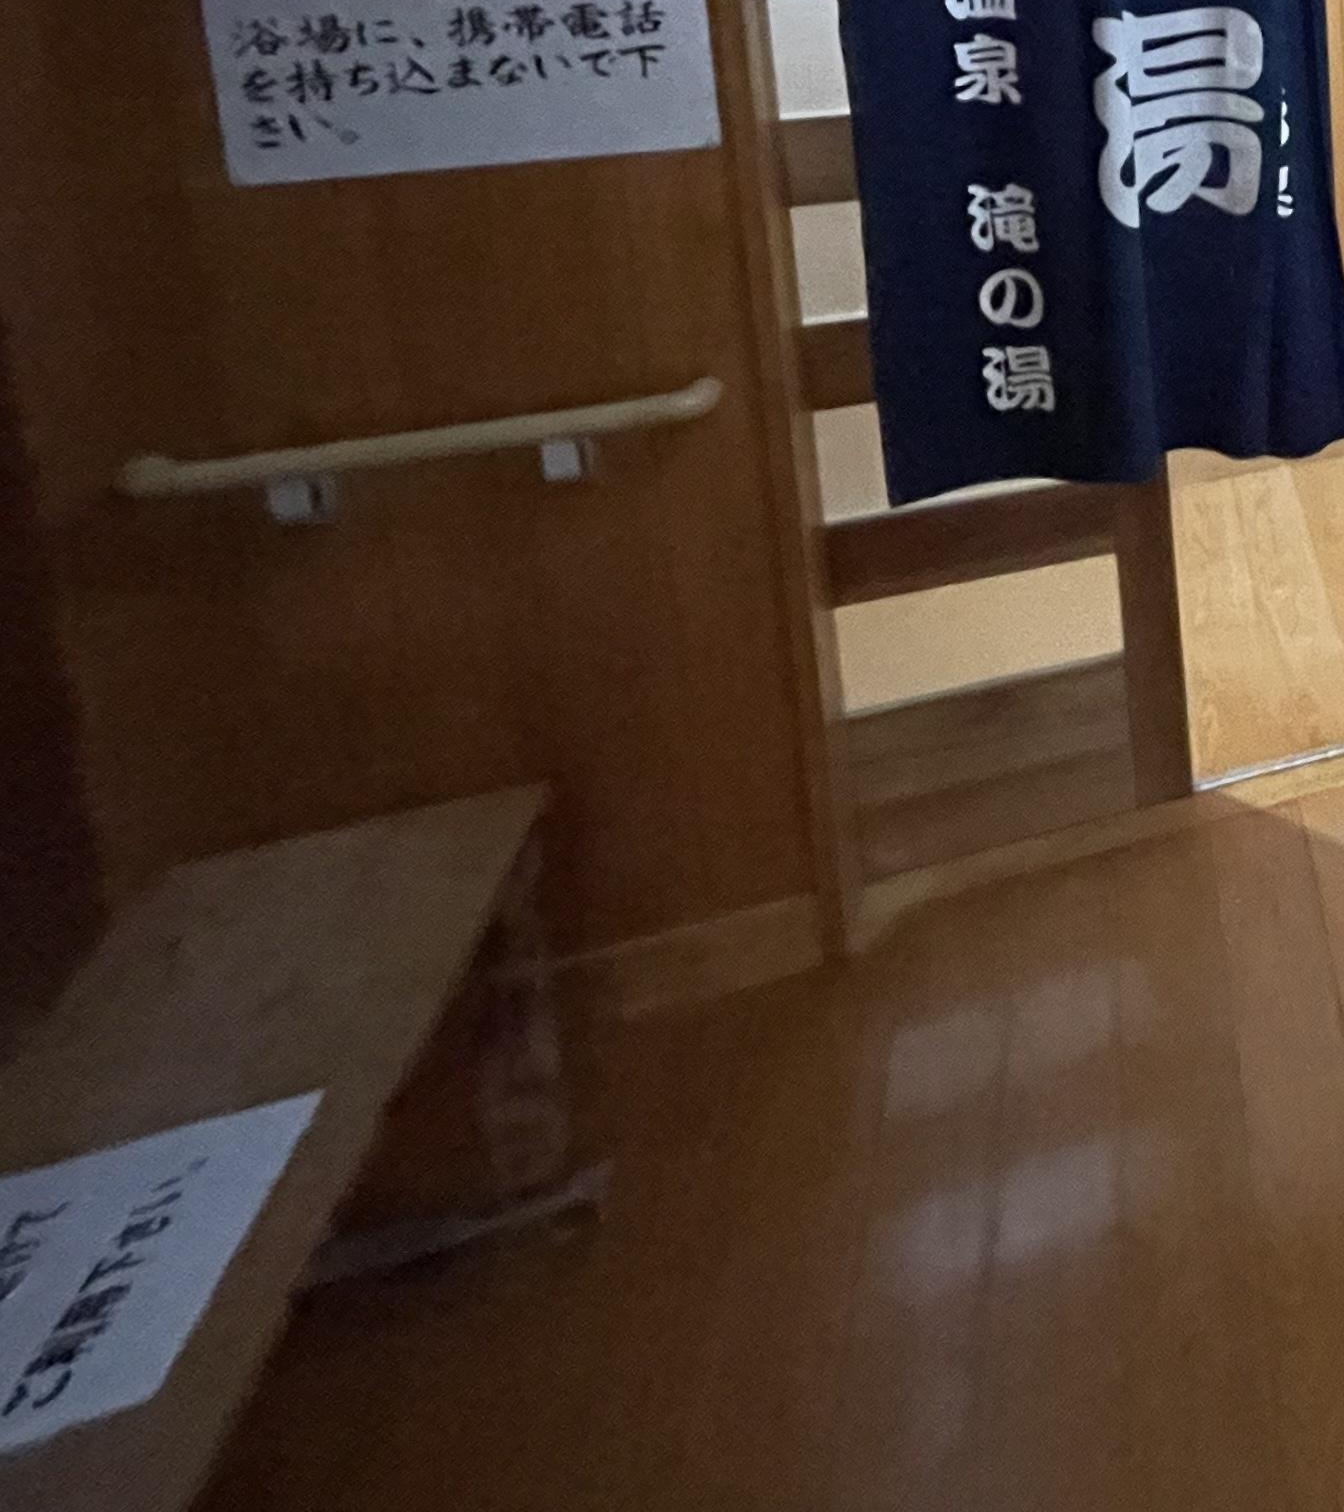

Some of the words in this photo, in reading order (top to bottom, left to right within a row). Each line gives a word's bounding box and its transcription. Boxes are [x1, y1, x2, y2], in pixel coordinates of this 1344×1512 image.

[233, 0, 665, 57] 浴場に、携帯電話
[241, 44, 666, 103] を持ち込まないで下
[251, 113, 358, 149] さい。
